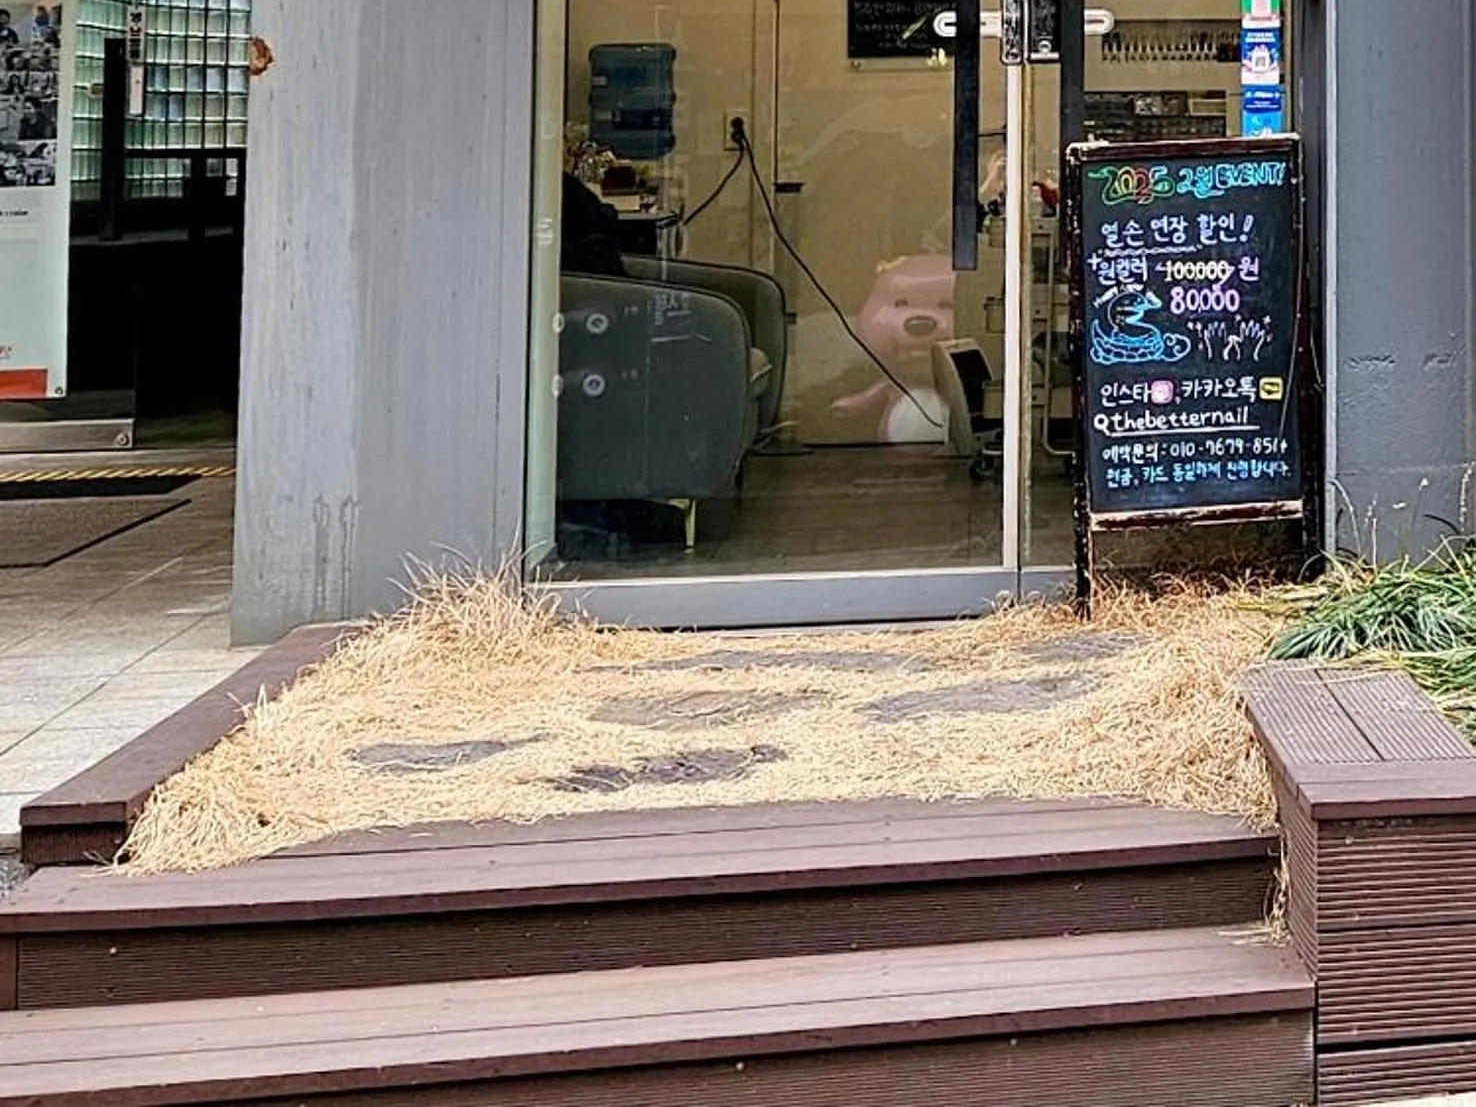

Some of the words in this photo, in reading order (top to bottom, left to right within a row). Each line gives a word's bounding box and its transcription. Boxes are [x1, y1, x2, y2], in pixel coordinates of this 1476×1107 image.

[1151, 215, 1189, 244] 연장
[1238, 256, 1260, 281] 원
[1141, 465, 1169, 483] 카드
